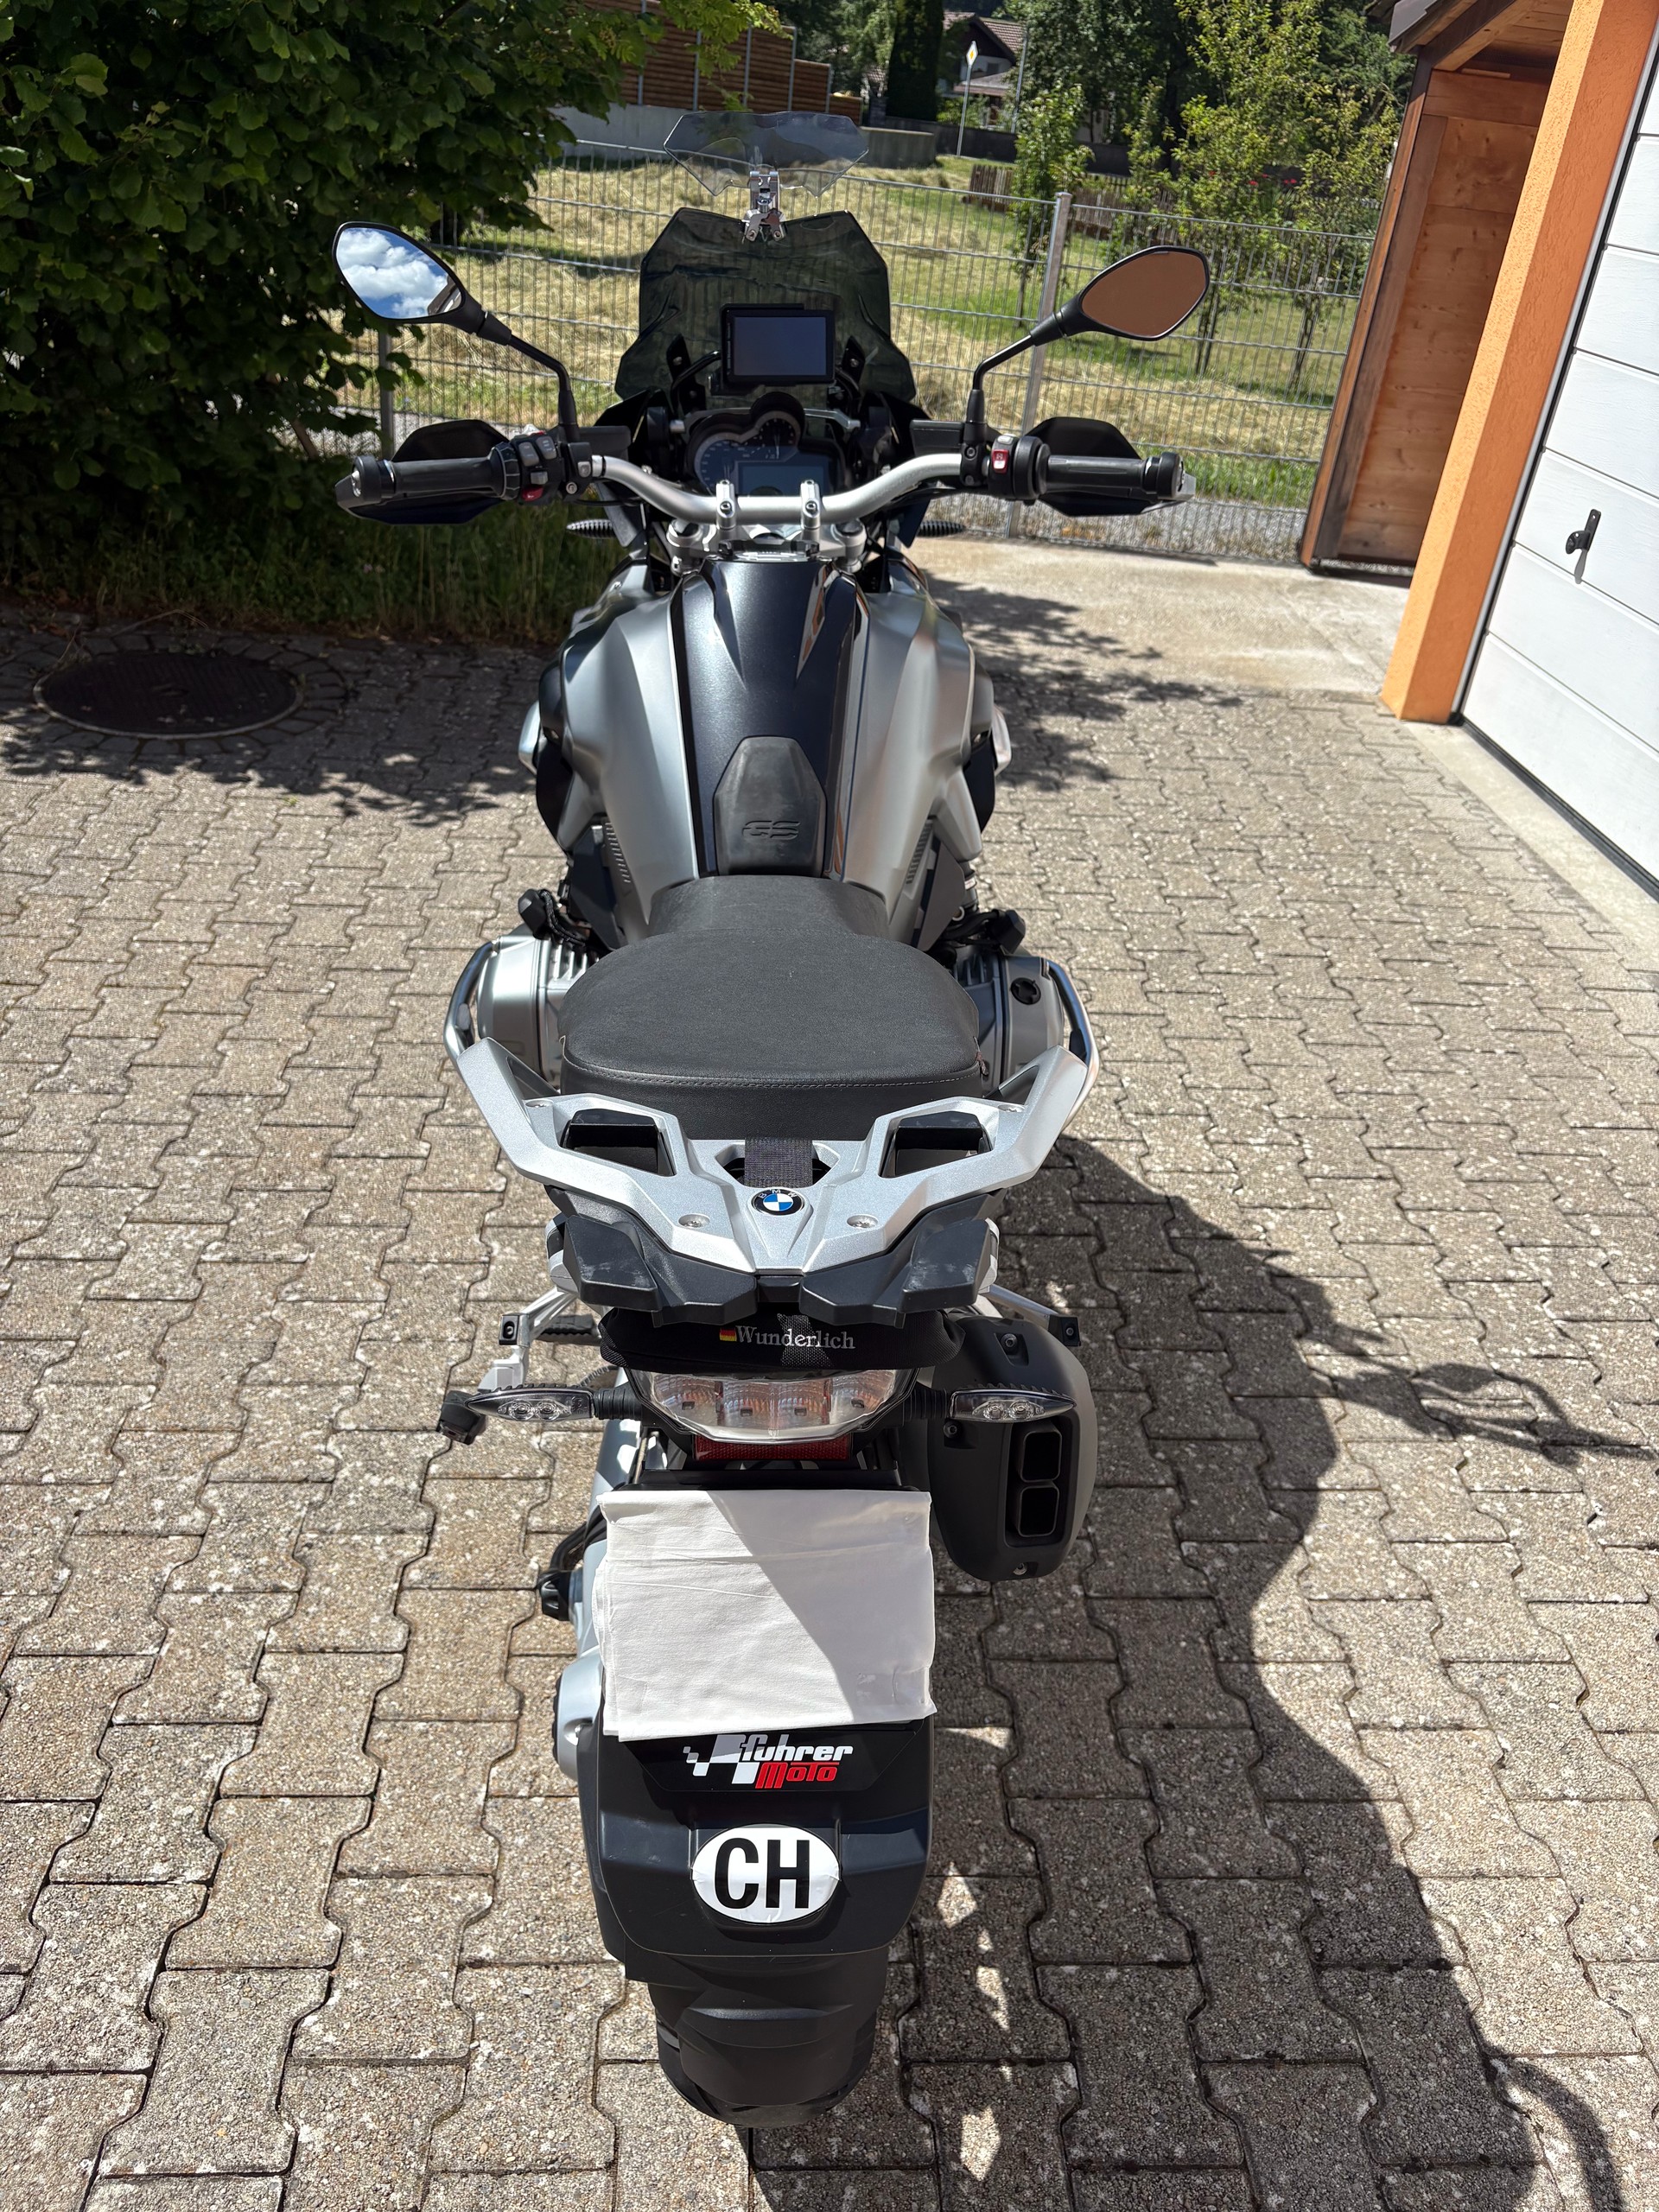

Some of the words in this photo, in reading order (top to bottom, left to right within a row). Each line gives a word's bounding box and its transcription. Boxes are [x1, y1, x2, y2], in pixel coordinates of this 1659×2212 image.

[742, 820, 800, 841] GS
[758, 1188, 798, 1199] BMW
[735, 1325, 855, 1350] Wunderlich
[714, 1837, 810, 1910] CH
